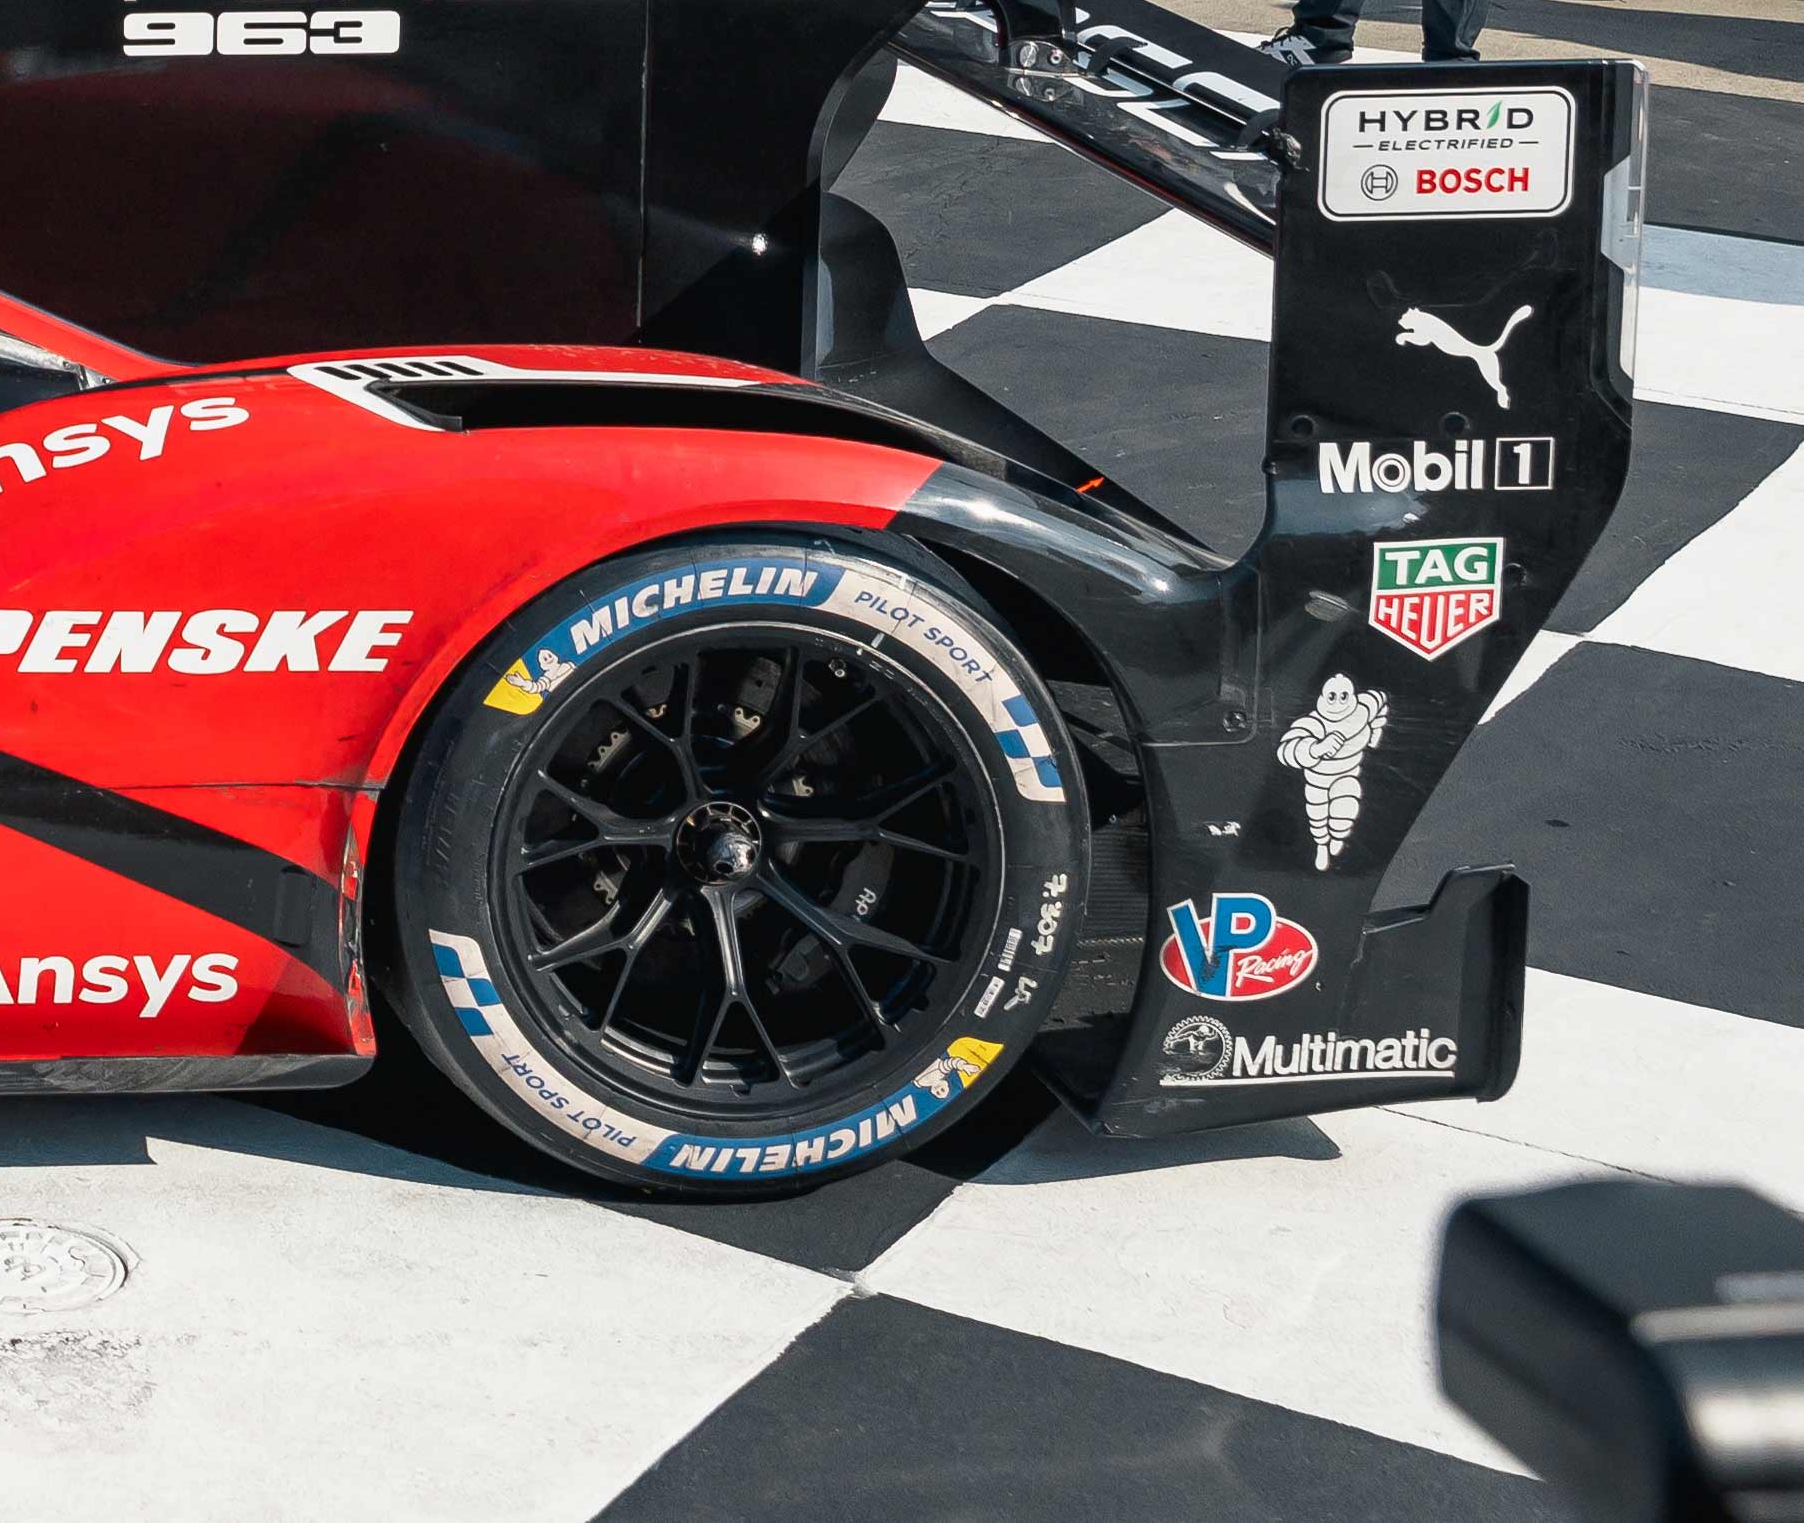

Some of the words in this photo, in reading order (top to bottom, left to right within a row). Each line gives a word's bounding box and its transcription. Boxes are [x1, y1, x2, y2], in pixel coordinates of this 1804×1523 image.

[123, 11, 400, 56] 963
[1378, 138, 1514, 152] ELECTRIFIED
[1416, 167, 1530, 194] BOSCH
[1319, 439, 1484, 493] Mobil
[1385, 546, 1490, 585] TAG
[570, 566, 818, 658] MICHELIN
[854, 589, 925, 631] PILOT
[921, 624, 993, 685] SPORT
[1377, 591, 1493, 655] HEUER
[1167, 893, 1277, 998] VP
[1235, 949, 1312, 987] Racing
[1233, 1029, 1458, 1078] Multimatic
[500, 1052, 572, 1120] SPORT
[581, 1110, 638, 1150] PILOT
[671, 1094, 919, 1175] MICHELIN
